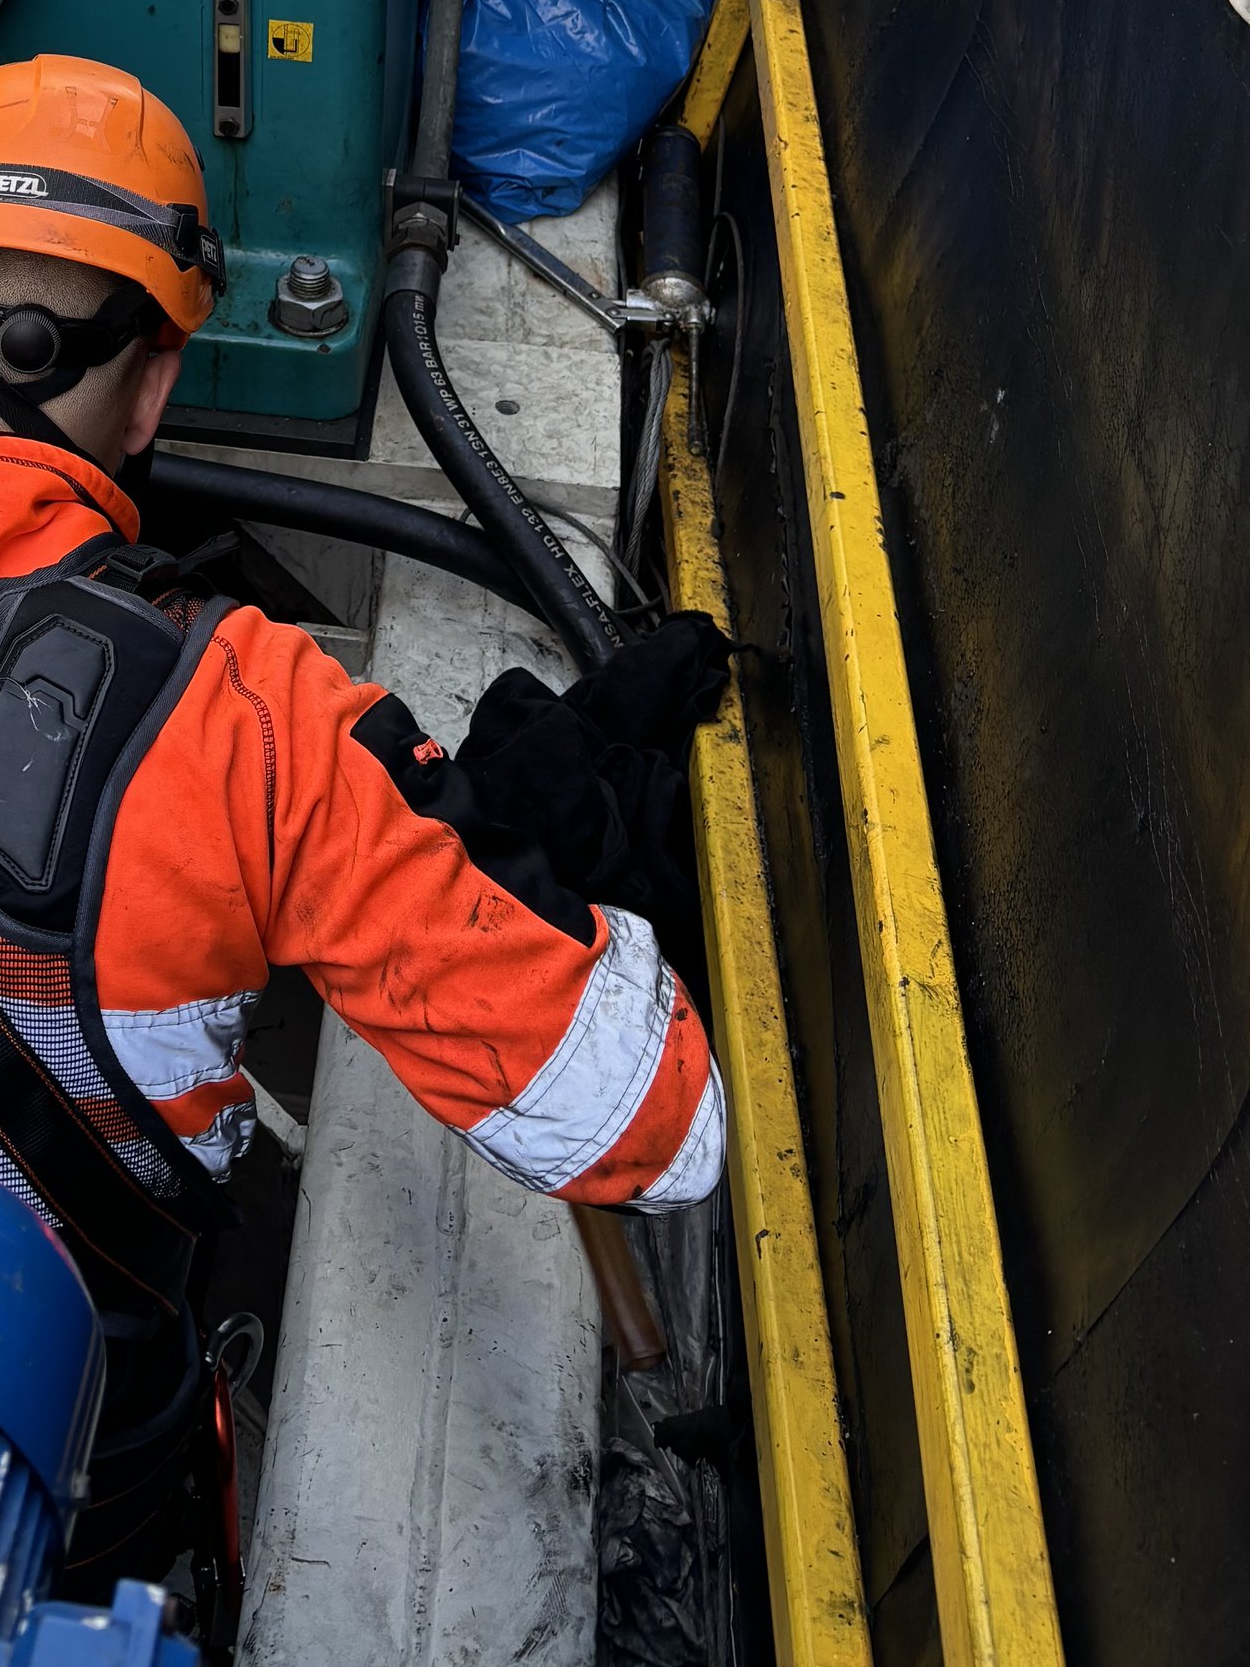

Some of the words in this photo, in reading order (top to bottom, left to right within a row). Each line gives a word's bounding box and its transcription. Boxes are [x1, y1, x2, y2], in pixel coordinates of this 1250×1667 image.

[201, 237, 218, 266] PETZ
[418, 344, 437, 369] BAR
[431, 371, 447, 386] 63
[439, 389, 459, 411] WP
[453, 414, 470, 429] 31
[486, 461, 524, 506] EN853
[521, 508, 543, 533] 132
[543, 535, 565, 559] HD
